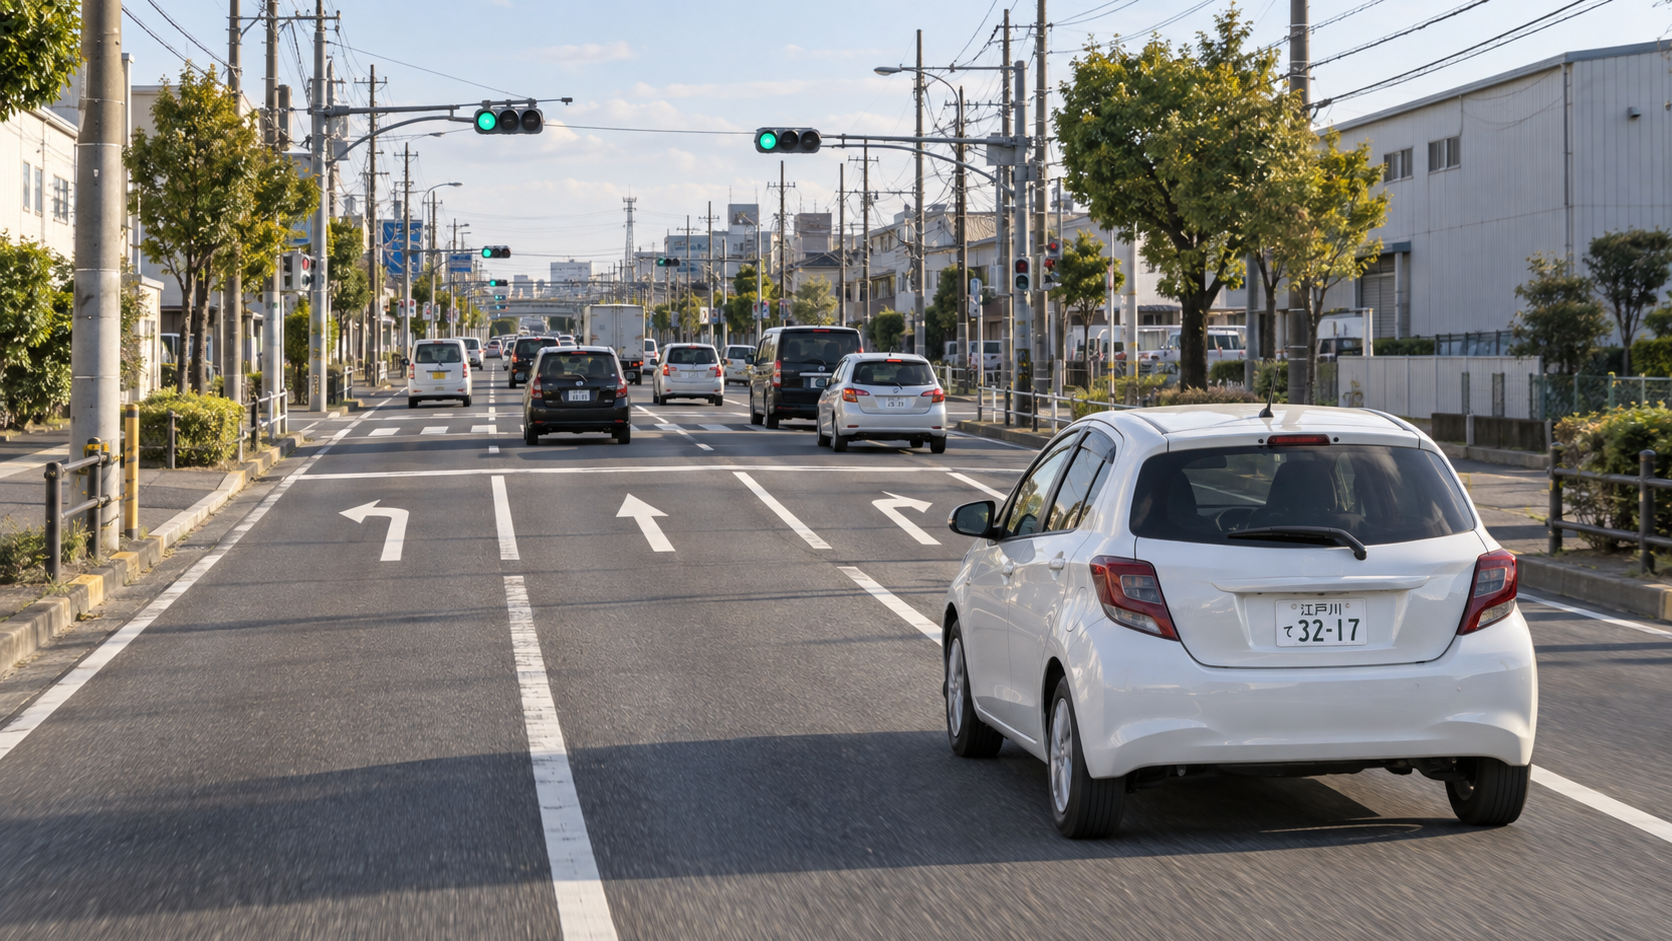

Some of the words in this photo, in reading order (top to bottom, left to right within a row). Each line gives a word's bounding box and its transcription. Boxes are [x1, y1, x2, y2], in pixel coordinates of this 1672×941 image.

[1300, 603, 1342, 616] 江戸川
[1283, 625, 1293, 638] て
[1298, 618, 1361, 643] 32-17
